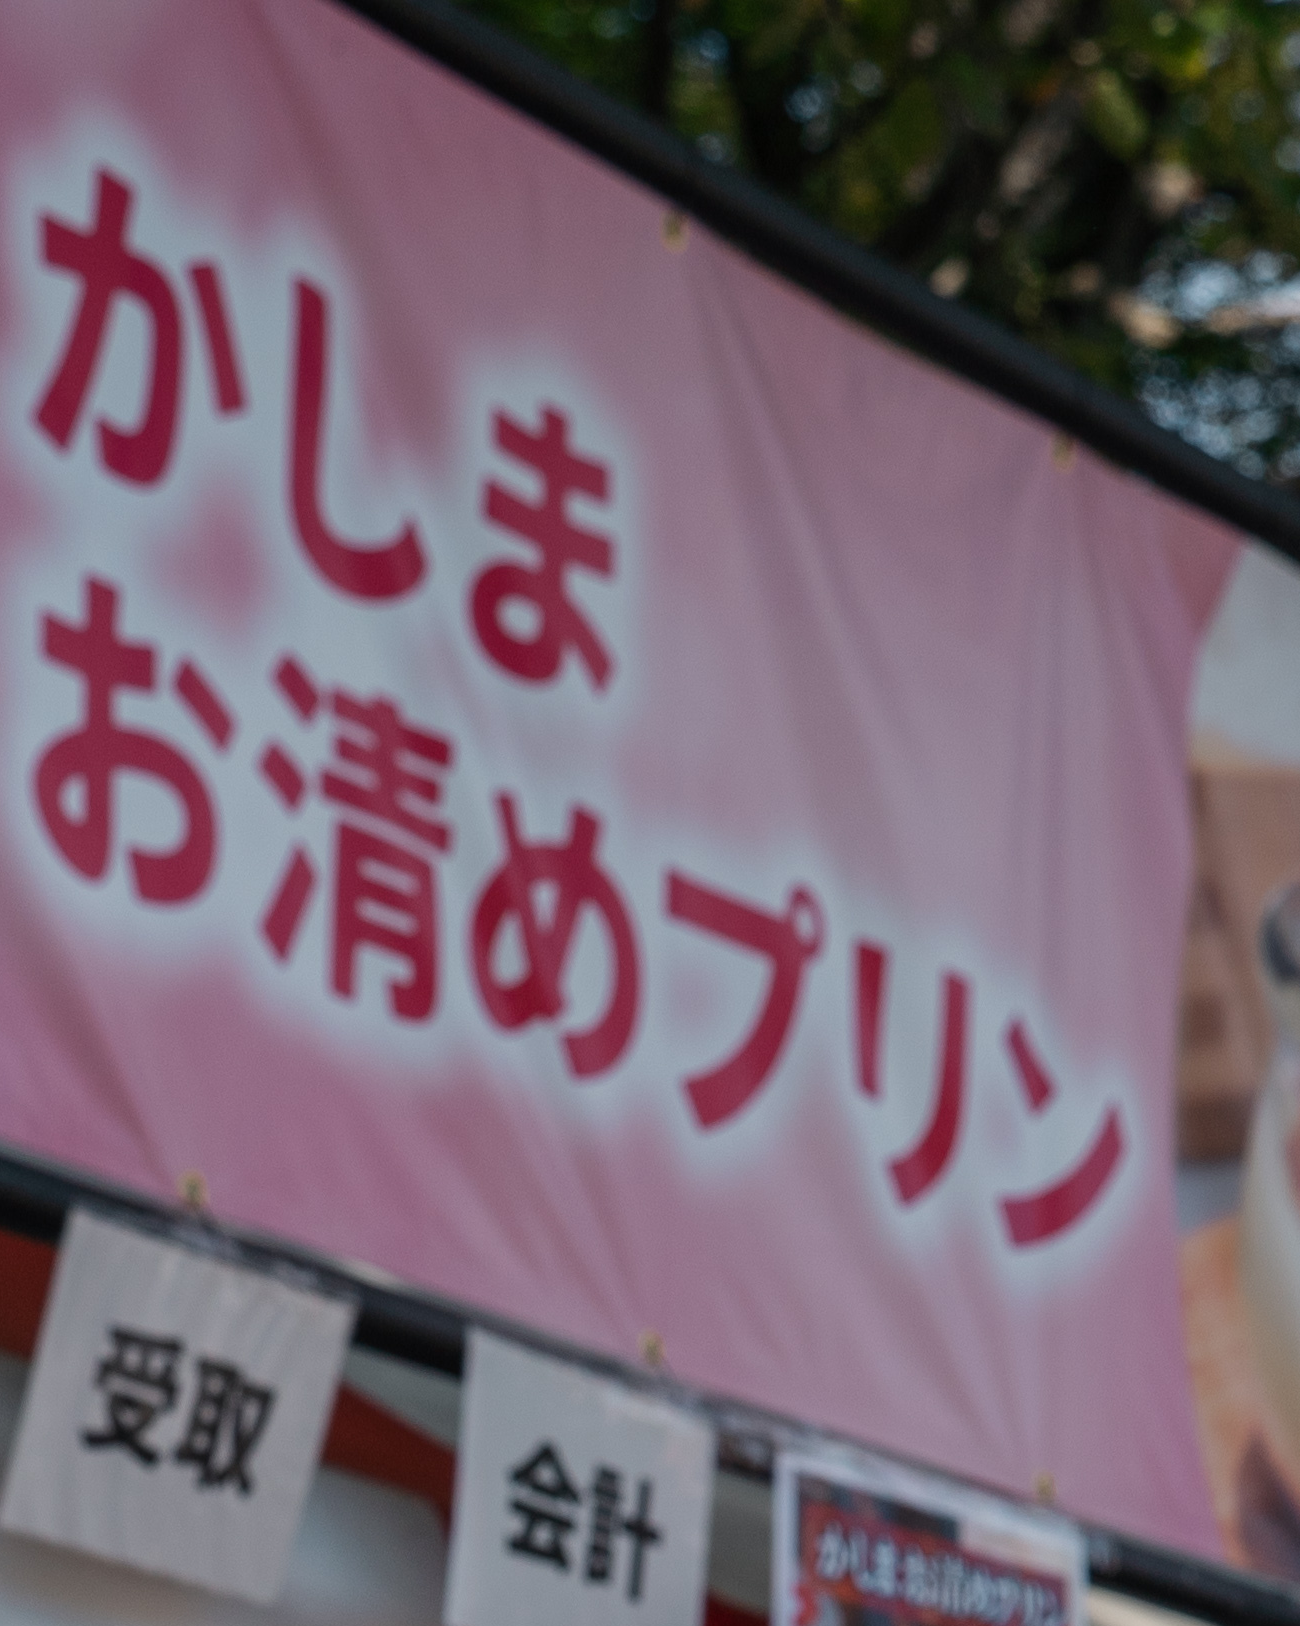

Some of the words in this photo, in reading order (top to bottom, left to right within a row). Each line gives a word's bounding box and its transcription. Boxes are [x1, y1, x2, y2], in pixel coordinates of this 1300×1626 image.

[31, 161, 616, 697] かしま
[31, 572, 1127, 1250] お清めプリン
[81, 1326, 277, 1497] 受取
[508, 1440, 663, 1603] 会計
